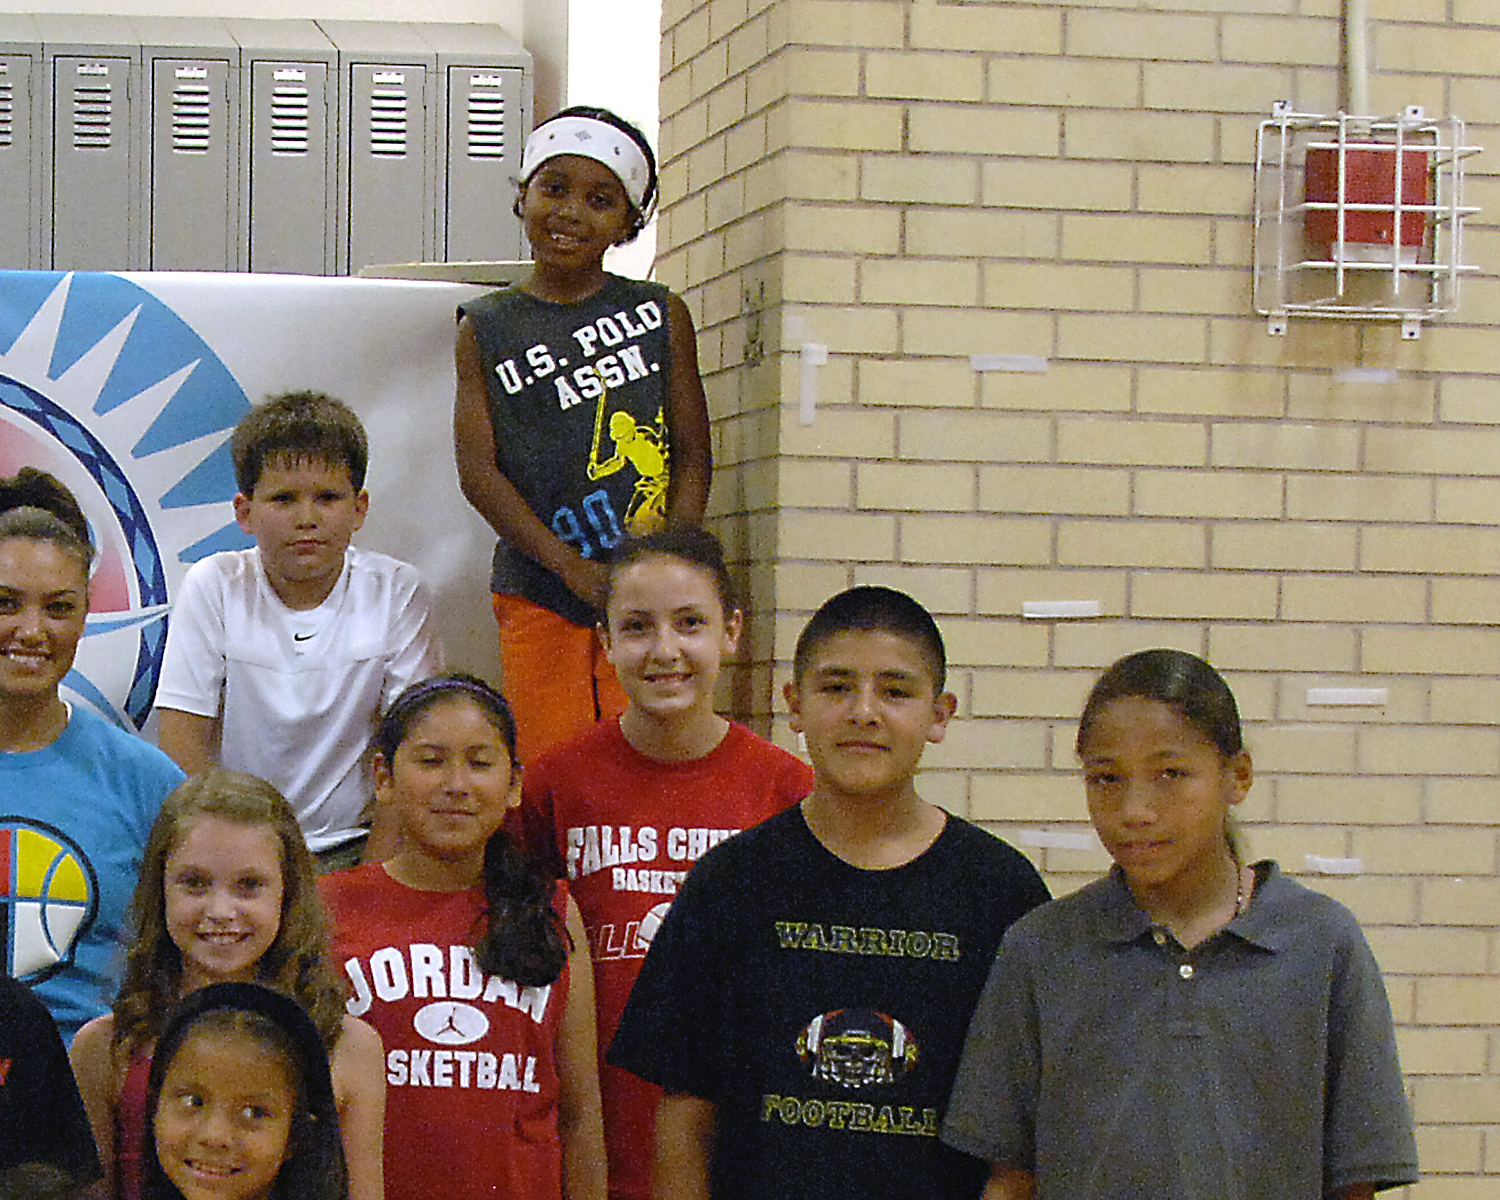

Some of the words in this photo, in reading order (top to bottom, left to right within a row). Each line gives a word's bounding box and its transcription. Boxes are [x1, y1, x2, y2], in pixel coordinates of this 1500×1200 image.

[495, 344, 568, 395] U.S.
[573, 301, 663, 357] POLO
[554, 345, 660, 410] ASSN.
[552, 489, 621, 558] 90
[566, 826, 658, 880] FALLS
[775, 921, 961, 962] WARRIOR
